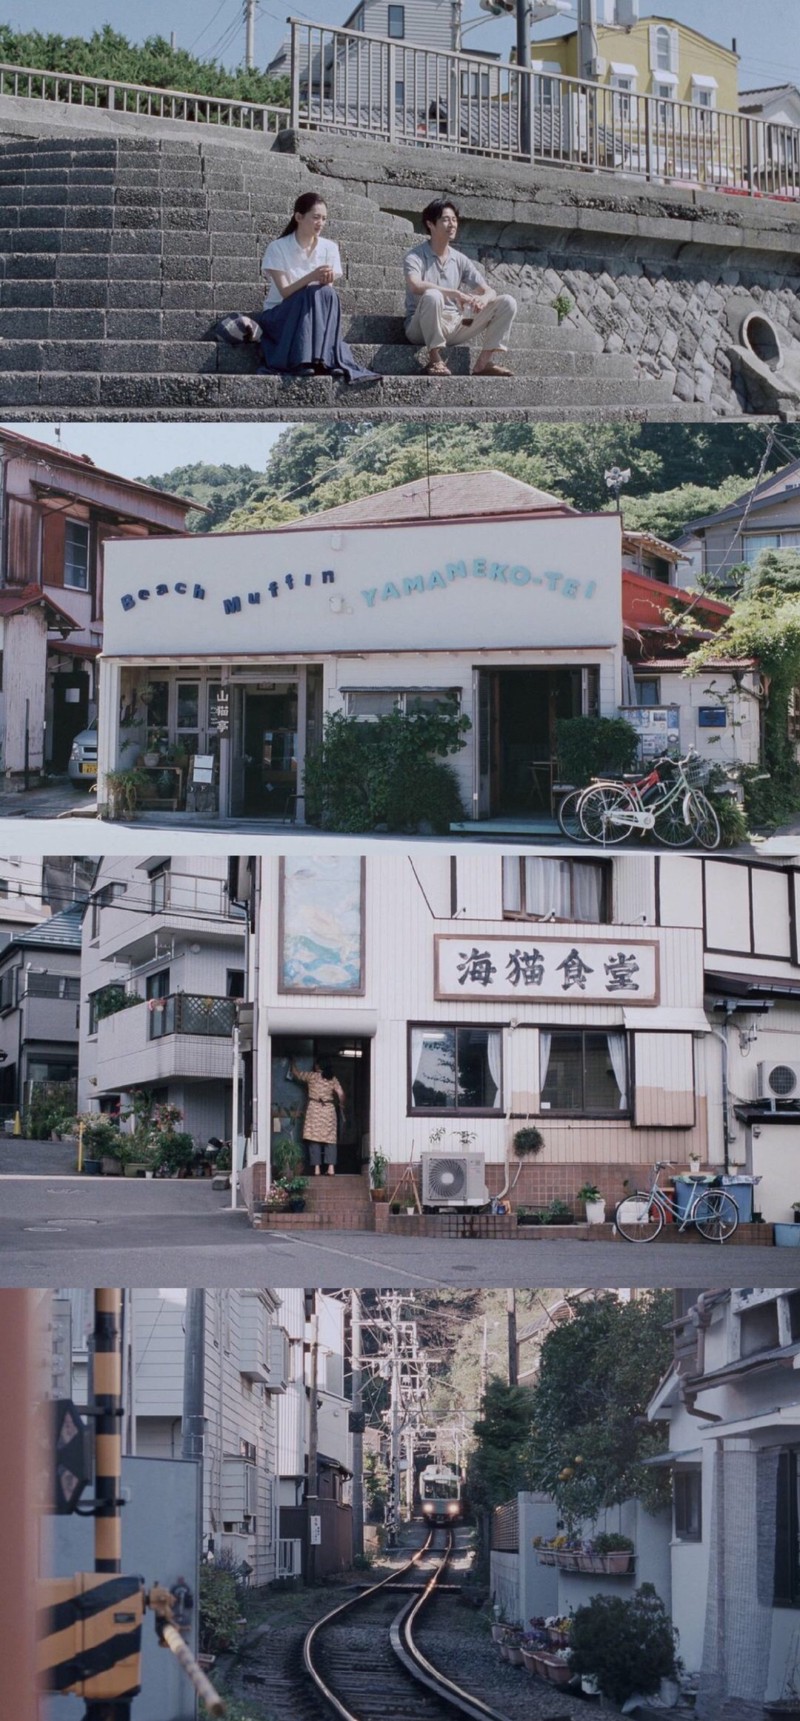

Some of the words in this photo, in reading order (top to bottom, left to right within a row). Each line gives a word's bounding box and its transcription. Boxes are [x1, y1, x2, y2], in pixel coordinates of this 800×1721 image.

[120, 582, 206, 611] Beach
[223, 570, 335, 615] Muffin
[360, 558, 597, 608] YAMANEKO-TEI
[217, 690, 229, 733] 山猫亭
[457, 947, 640, 992] 海猫食堂
